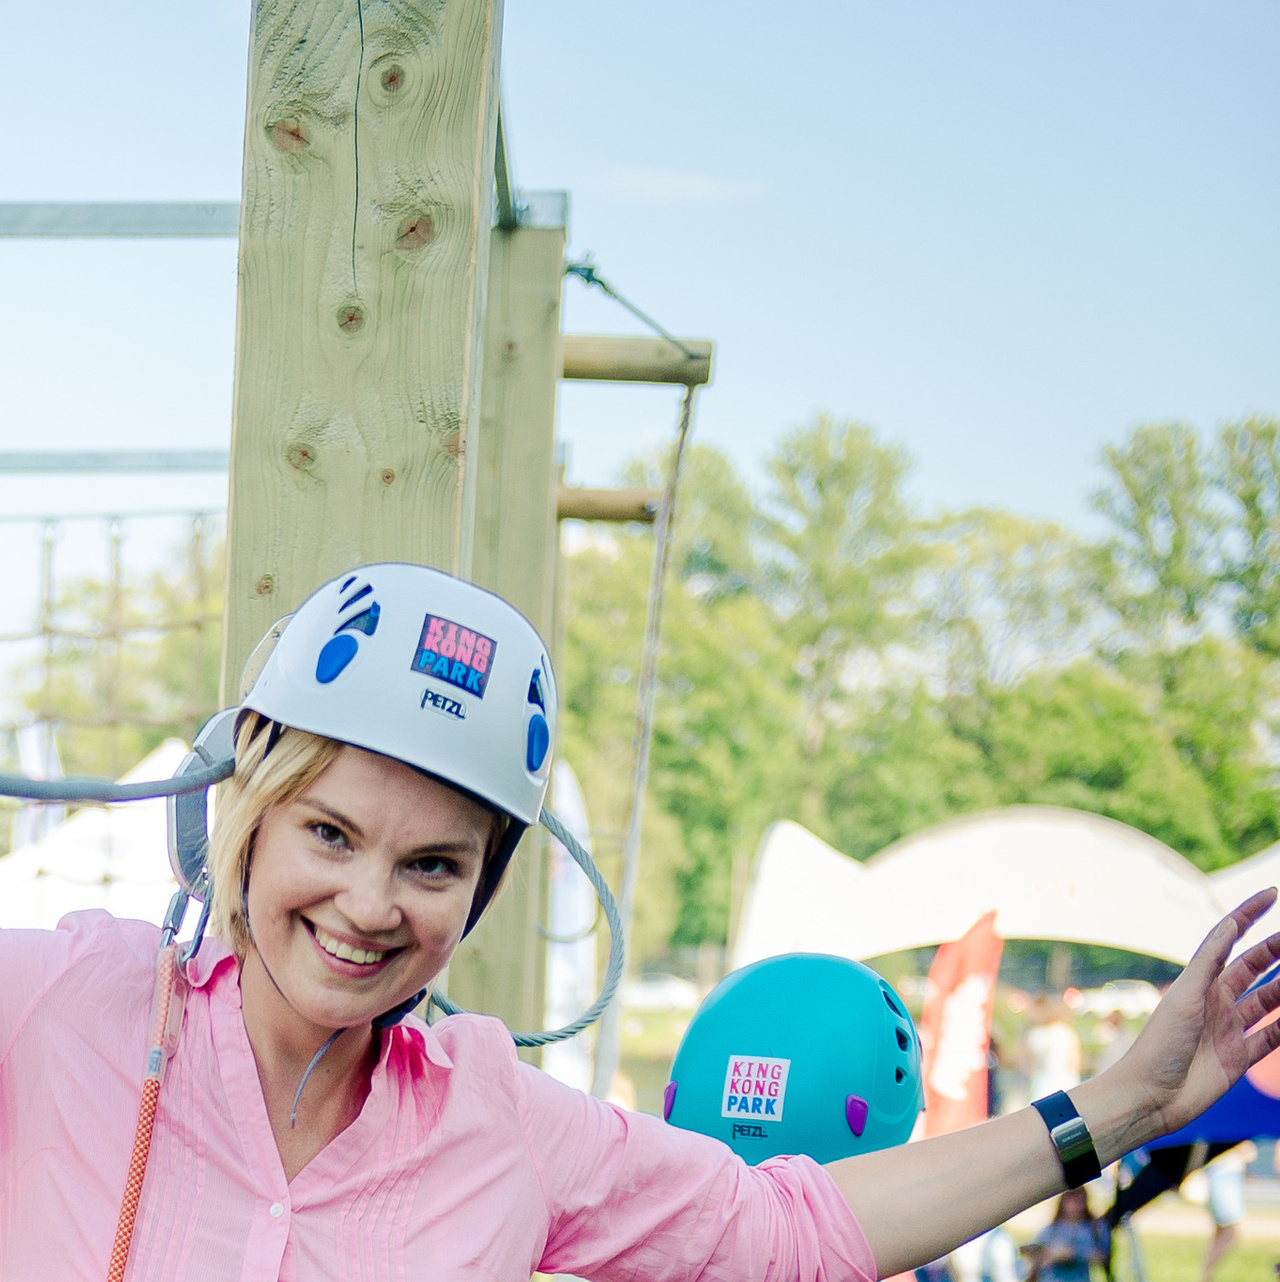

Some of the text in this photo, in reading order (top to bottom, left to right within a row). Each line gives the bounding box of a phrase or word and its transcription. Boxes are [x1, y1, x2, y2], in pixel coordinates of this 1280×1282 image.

[429, 617, 492, 656] KING
[423, 632, 489, 674] KONG
[418, 650, 484, 693] PARK
[421, 688, 466, 719] PETZL
[732, 1061, 783, 1080] KING
[729, 1078, 780, 1097] KONG
[727, 1095, 777, 1115] PARK
[732, 1123, 768, 1140] PETZL
